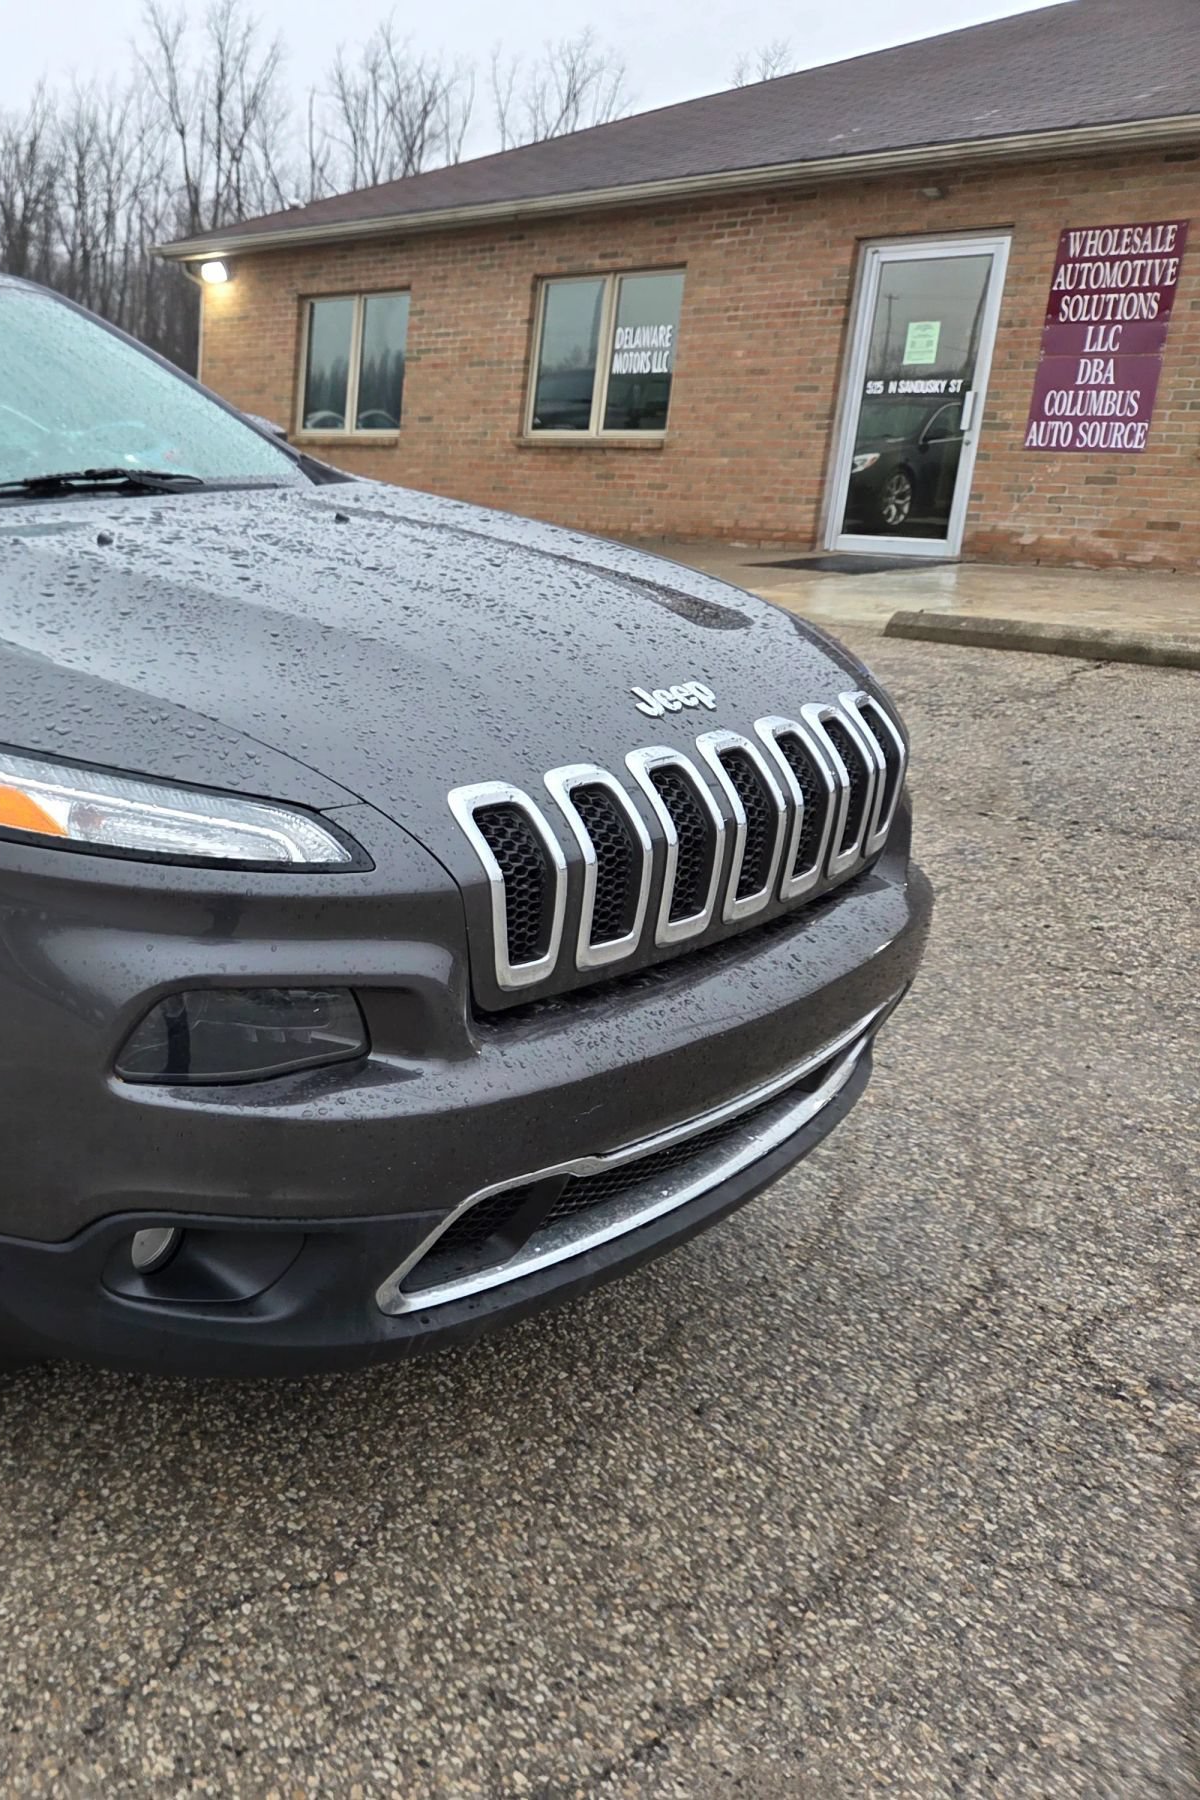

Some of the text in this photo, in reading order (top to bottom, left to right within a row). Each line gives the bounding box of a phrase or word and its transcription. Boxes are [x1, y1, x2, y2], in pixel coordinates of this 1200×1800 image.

[1068, 224, 1179, 258] WHOLESALE
[1052, 257, 1180, 291] AUTOMOTIVE
[1058, 291, 1161, 323] SOLUTIONS
[614, 324, 673, 350] DELAWARE
[1083, 324, 1123, 353] LLC
[611, 350, 670, 375] MOTORS LLC
[1074, 357, 1116, 385] DBA
[887, 380, 898, 394] N
[898, 380, 947, 394] SANDUSKY
[948, 379, 964, 393] ST
[1043, 389, 1141, 417] COLUMBUS
[1025, 421, 1149, 449] AUTO SOURCE
[630, 681, 717, 717] Jeep
